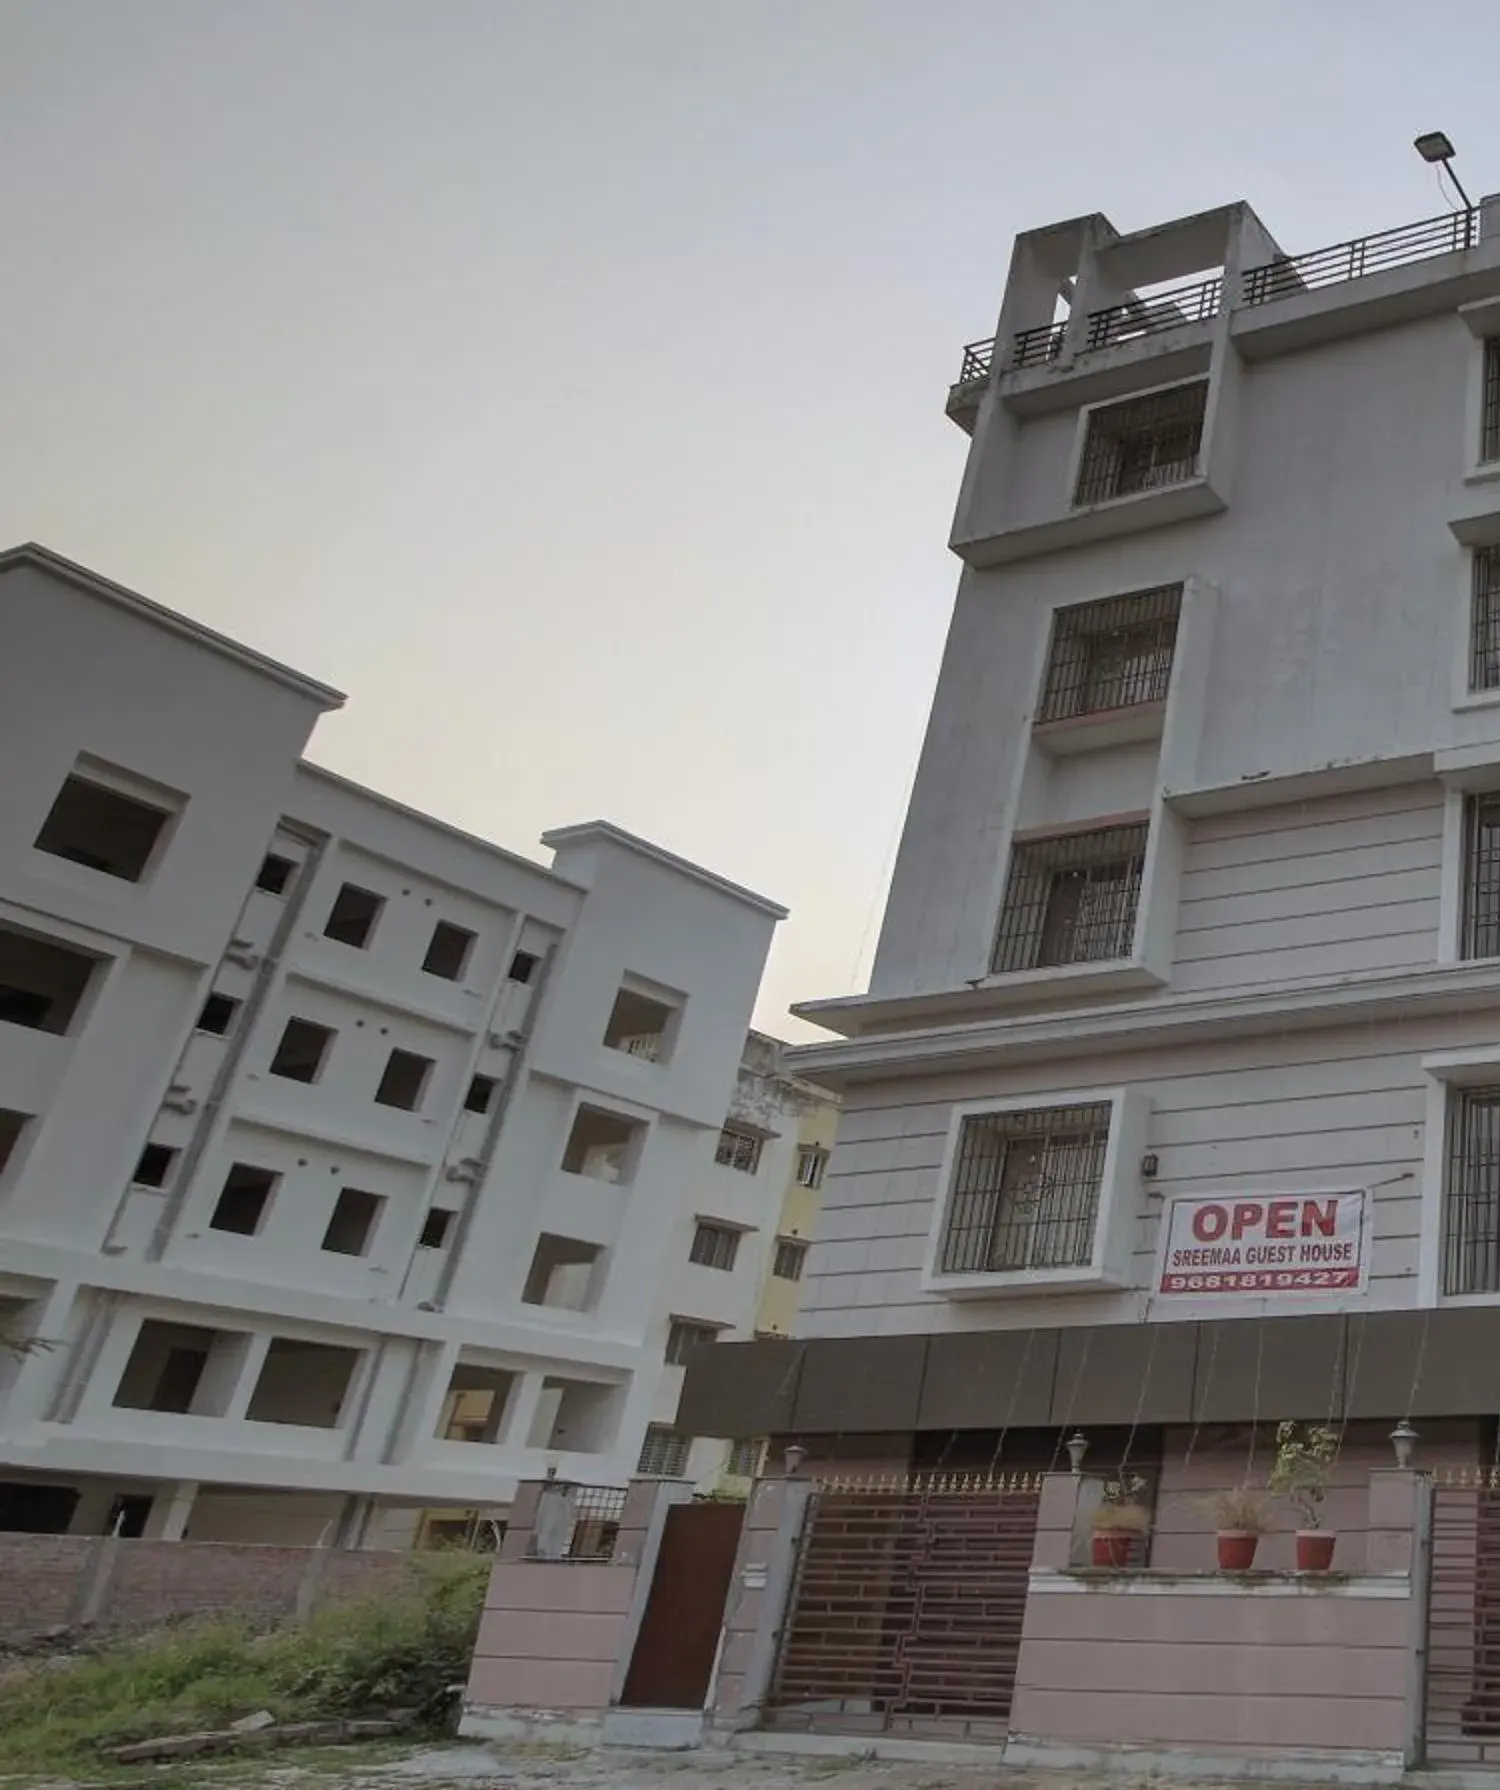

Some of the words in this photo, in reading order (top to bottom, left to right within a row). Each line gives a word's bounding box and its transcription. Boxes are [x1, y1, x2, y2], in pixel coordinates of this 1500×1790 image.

[1192, 1200, 1338, 1242] OPEN
[1173, 1247, 1241, 1267] SREEMAA
[1245, 1245, 1296, 1265] GUEST
[1300, 1243, 1352, 1263] HOUSE
